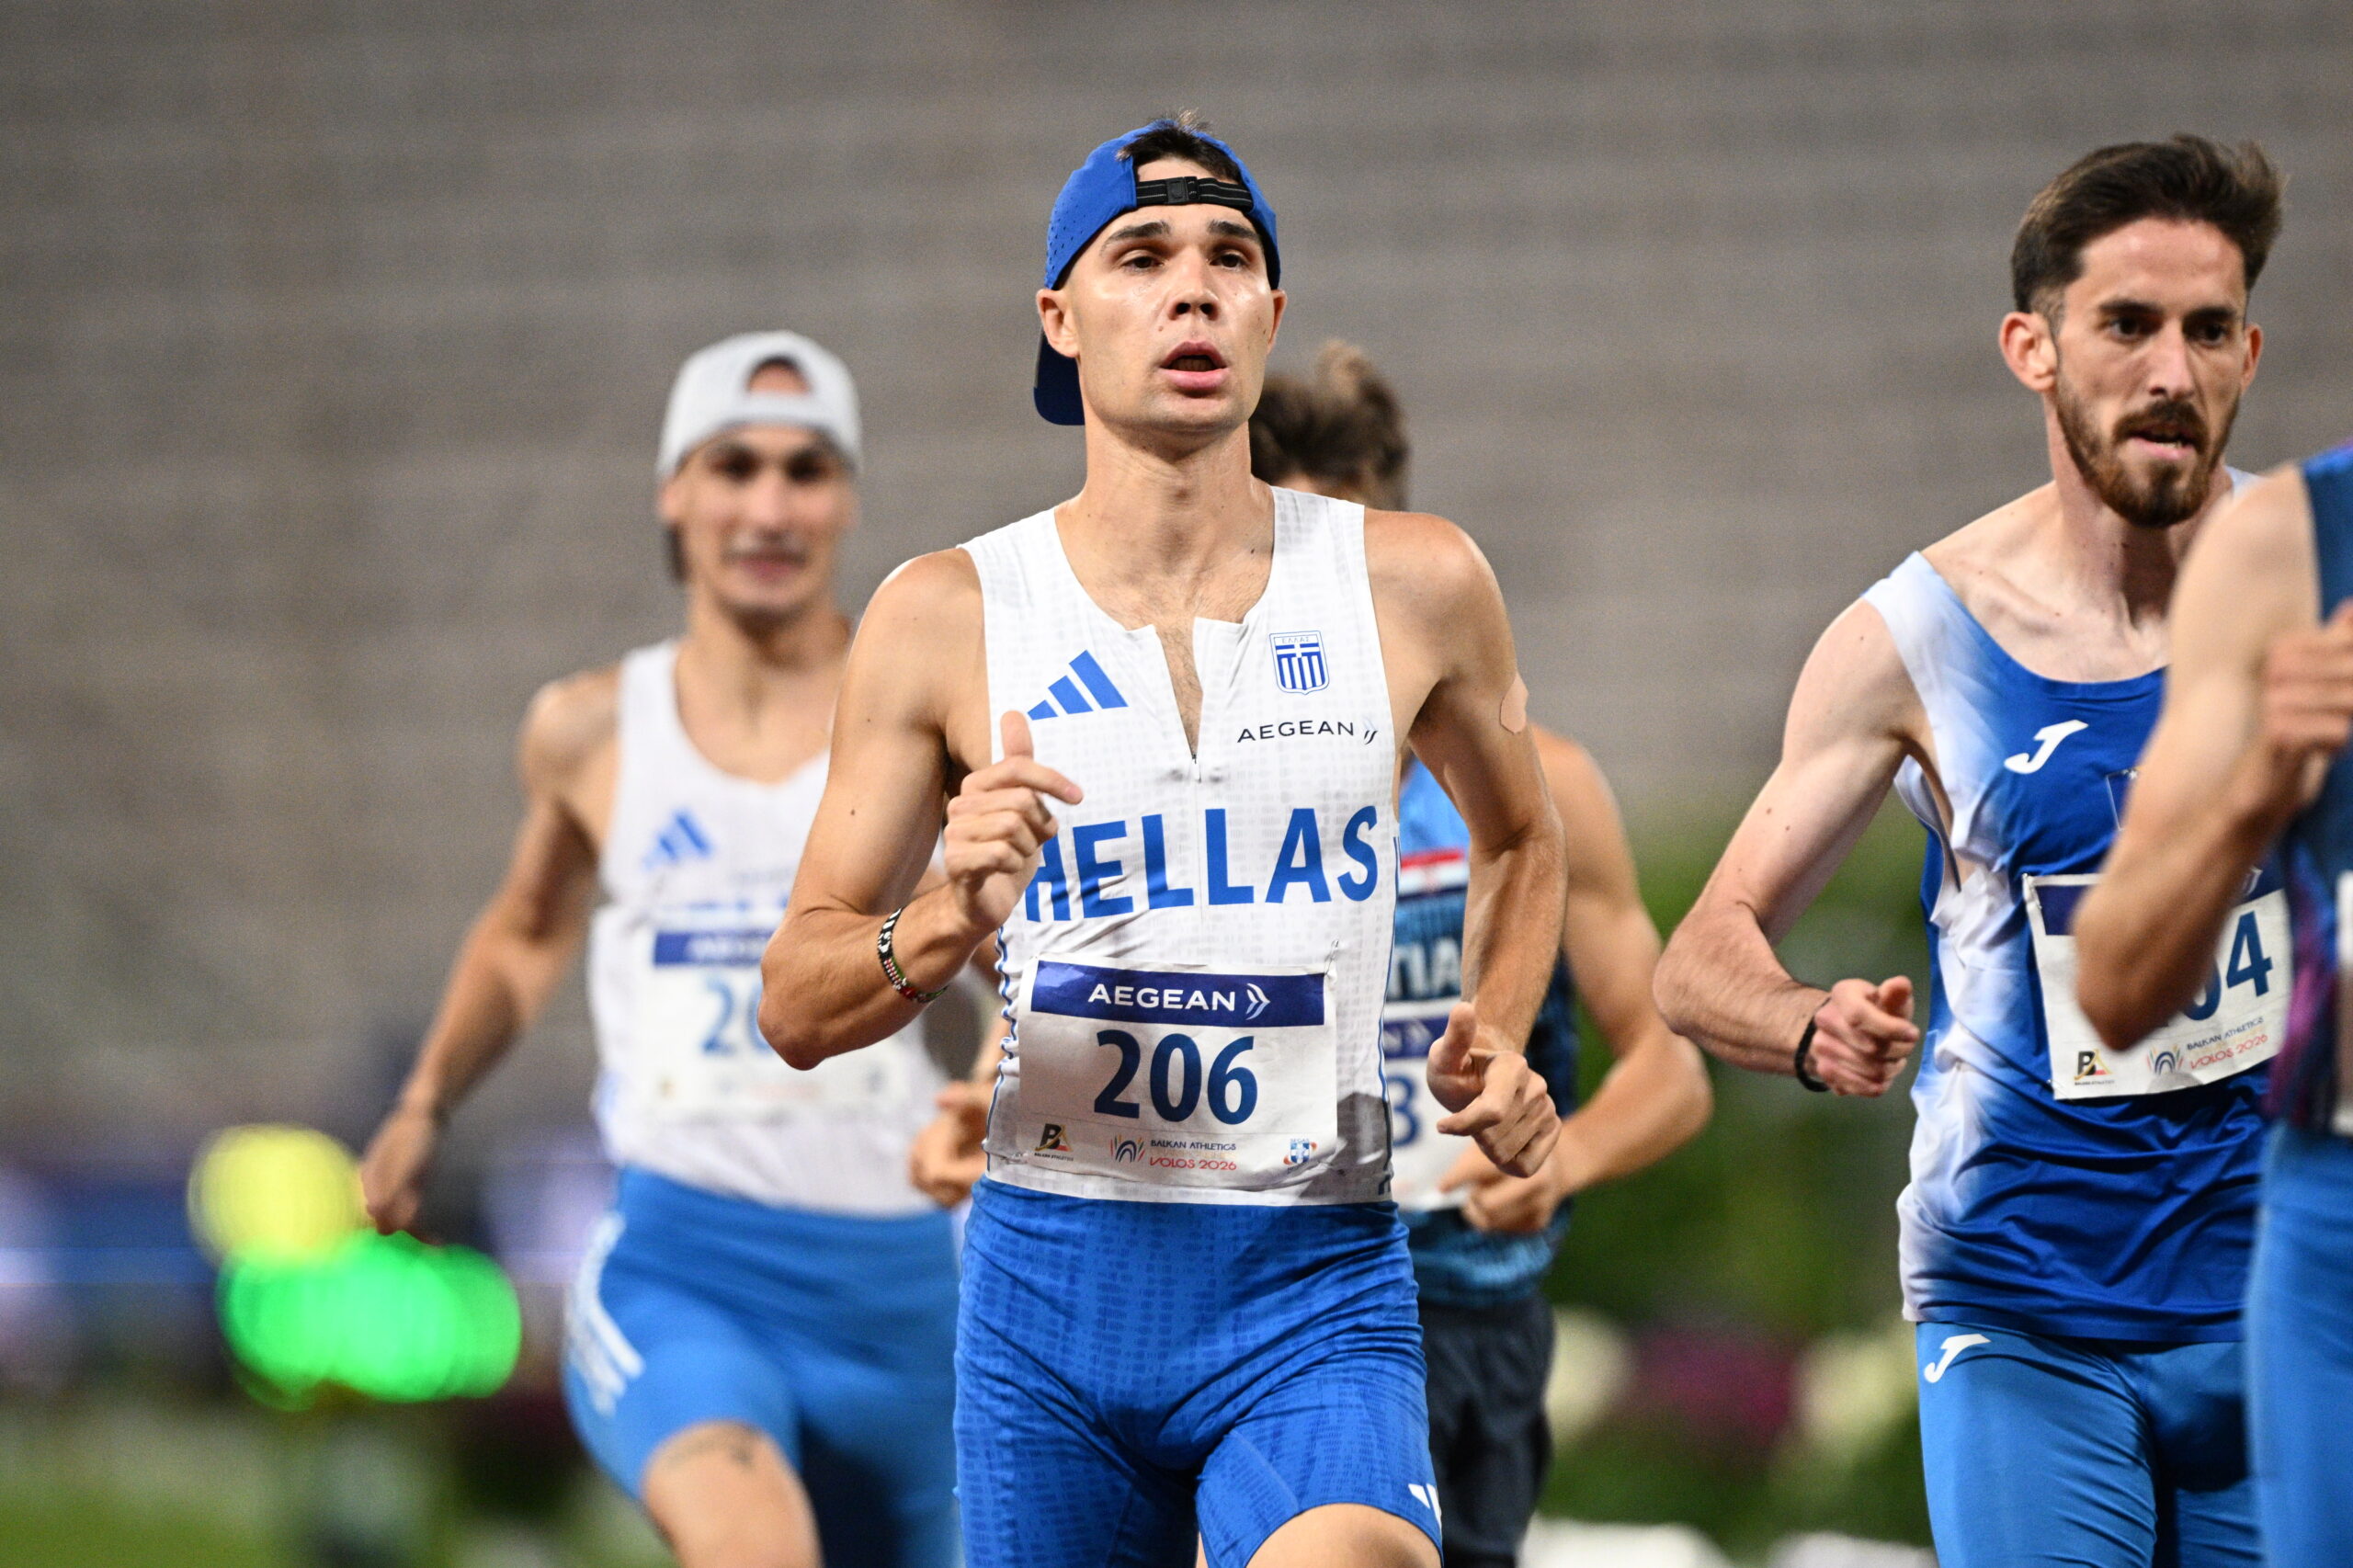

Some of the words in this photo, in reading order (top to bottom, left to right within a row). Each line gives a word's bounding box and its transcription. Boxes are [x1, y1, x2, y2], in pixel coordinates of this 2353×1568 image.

[1237, 721, 1354, 744] AEGEAN
[1025, 806, 1378, 923] HELLAS
[1088, 983, 1235, 1011] AEGEAN
[2187, 1034, 2222, 1051] BALKAN
[2224, 1016, 2264, 1039] ATHLETICS
[2190, 1047, 2234, 1069] VOLOS
[2236, 1034, 2268, 1054] 2026
[1094, 1029, 1257, 1125] 206
[1151, 1140, 1187, 1149] BALKAN
[1189, 1142, 1236, 1151] ATHLETICS
[1150, 1156, 1196, 1169] VOLOS
[1199, 1159, 1237, 1171] 2026
